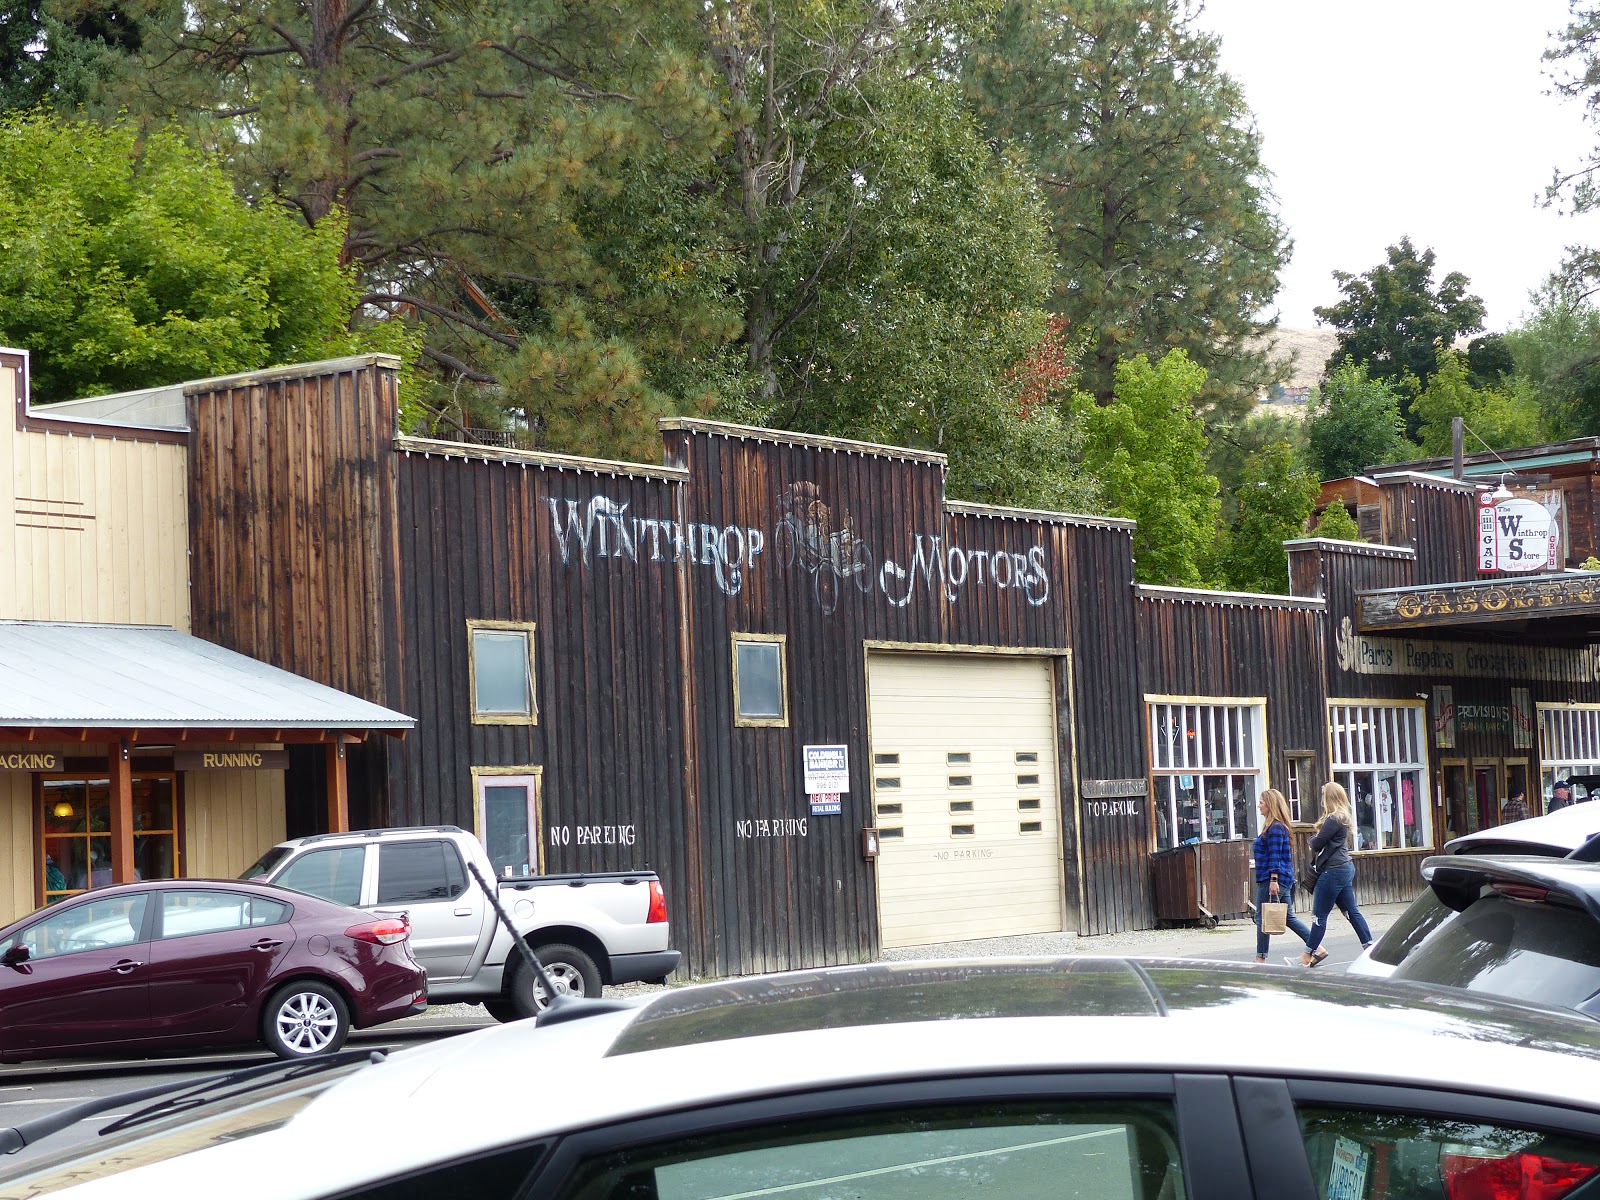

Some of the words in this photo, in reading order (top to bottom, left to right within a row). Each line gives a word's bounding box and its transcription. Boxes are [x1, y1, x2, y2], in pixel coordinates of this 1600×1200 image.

[1498, 515, 1548, 539] Winthrop
[541, 495, 765, 597] WINTHROP
[880, 533, 1050, 607] MOTORS
[1483, 536, 1493, 569] GAS
[1509, 539, 1540, 560] Store
[1397, 578, 1600, 618] GASOLIN
[1362, 641, 1393, 667] Parts
[1407, 643, 1454, 671] Repairs
[1466, 647, 1527, 673] Groceries
[1458, 706, 1510, 722] PROVISIONS
[203, 753, 262, 768] RUNNING
[808, 750, 844, 760] COLDWELL
[812, 793, 823, 803] NEW
[825, 792, 839, 802] PRICE
[812, 805, 824, 813] RETAIL
[551, 826, 570, 846] NO
[577, 824, 636, 846] PARKING
[737, 819, 752, 838] NO
[756, 818, 808, 837] PARKING
